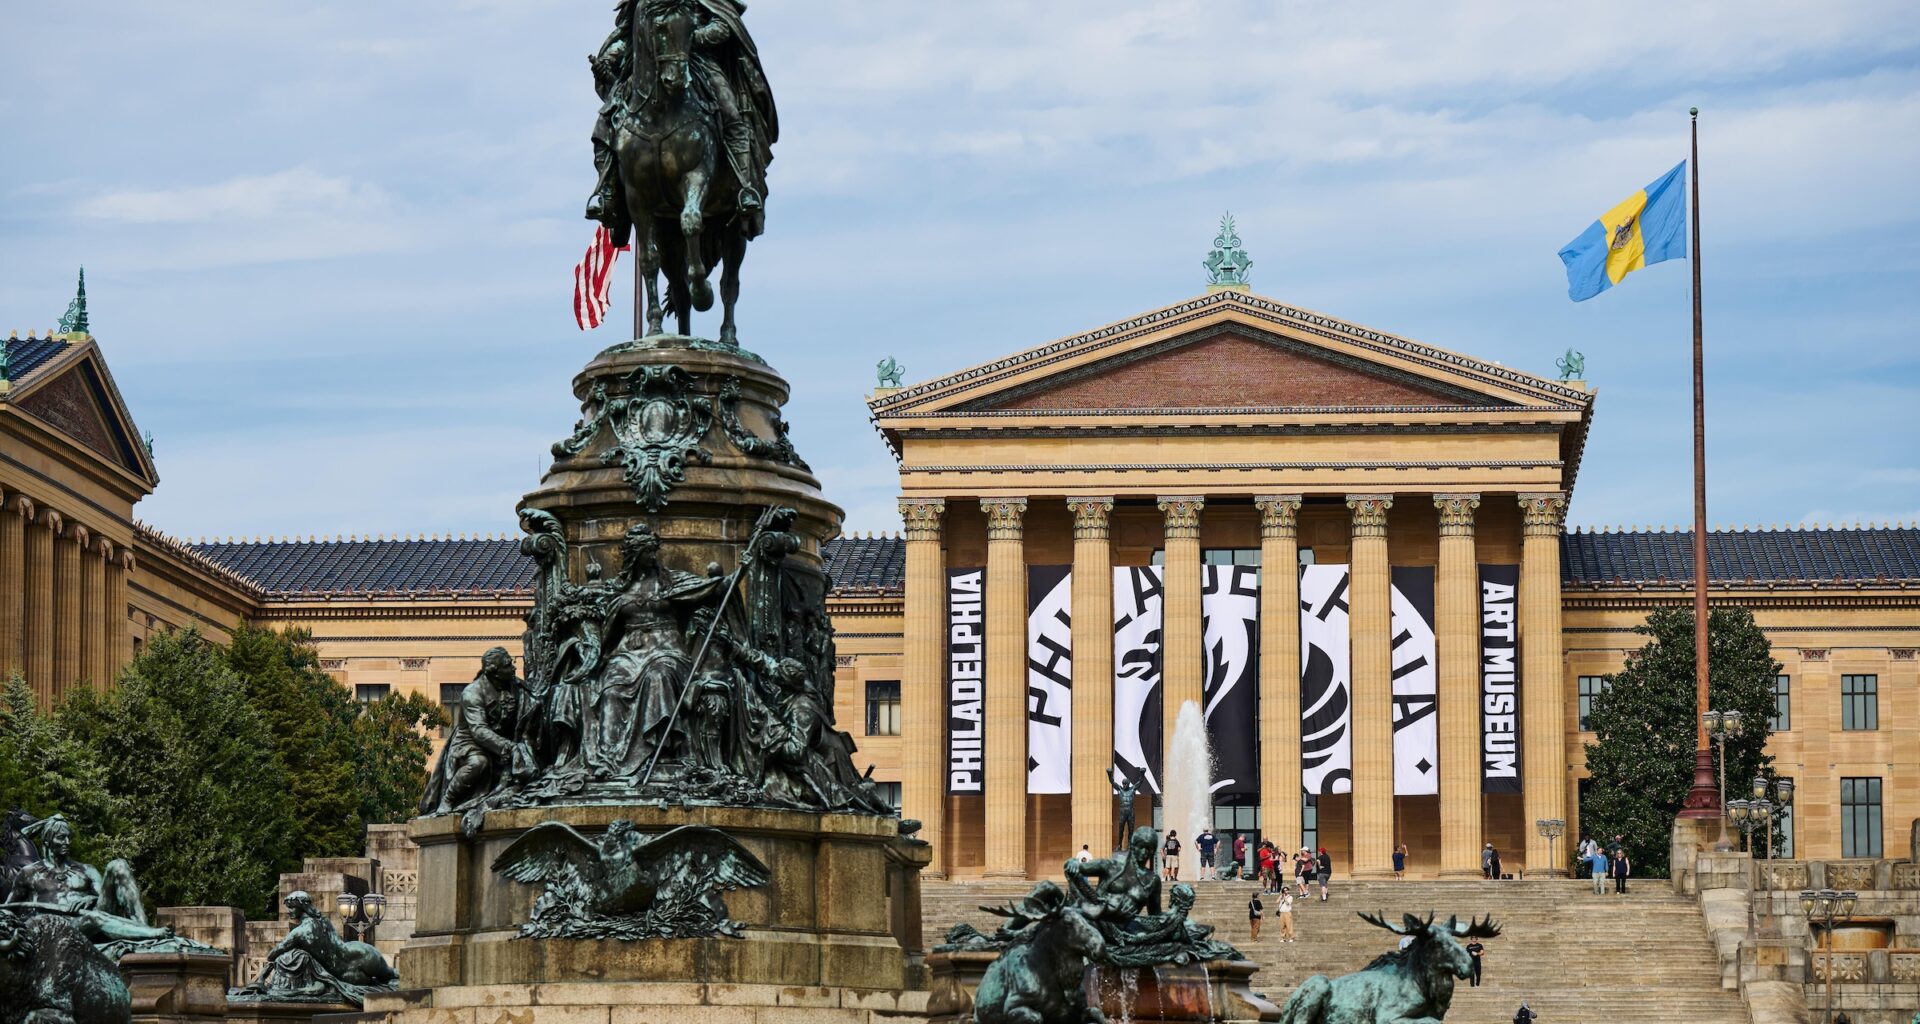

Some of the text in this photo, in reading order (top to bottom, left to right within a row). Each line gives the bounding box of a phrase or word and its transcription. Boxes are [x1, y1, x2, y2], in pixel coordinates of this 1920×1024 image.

[951, 570, 982, 791] PHILADELPHIA
[1483, 580, 1517, 778] ART MUSEUM
